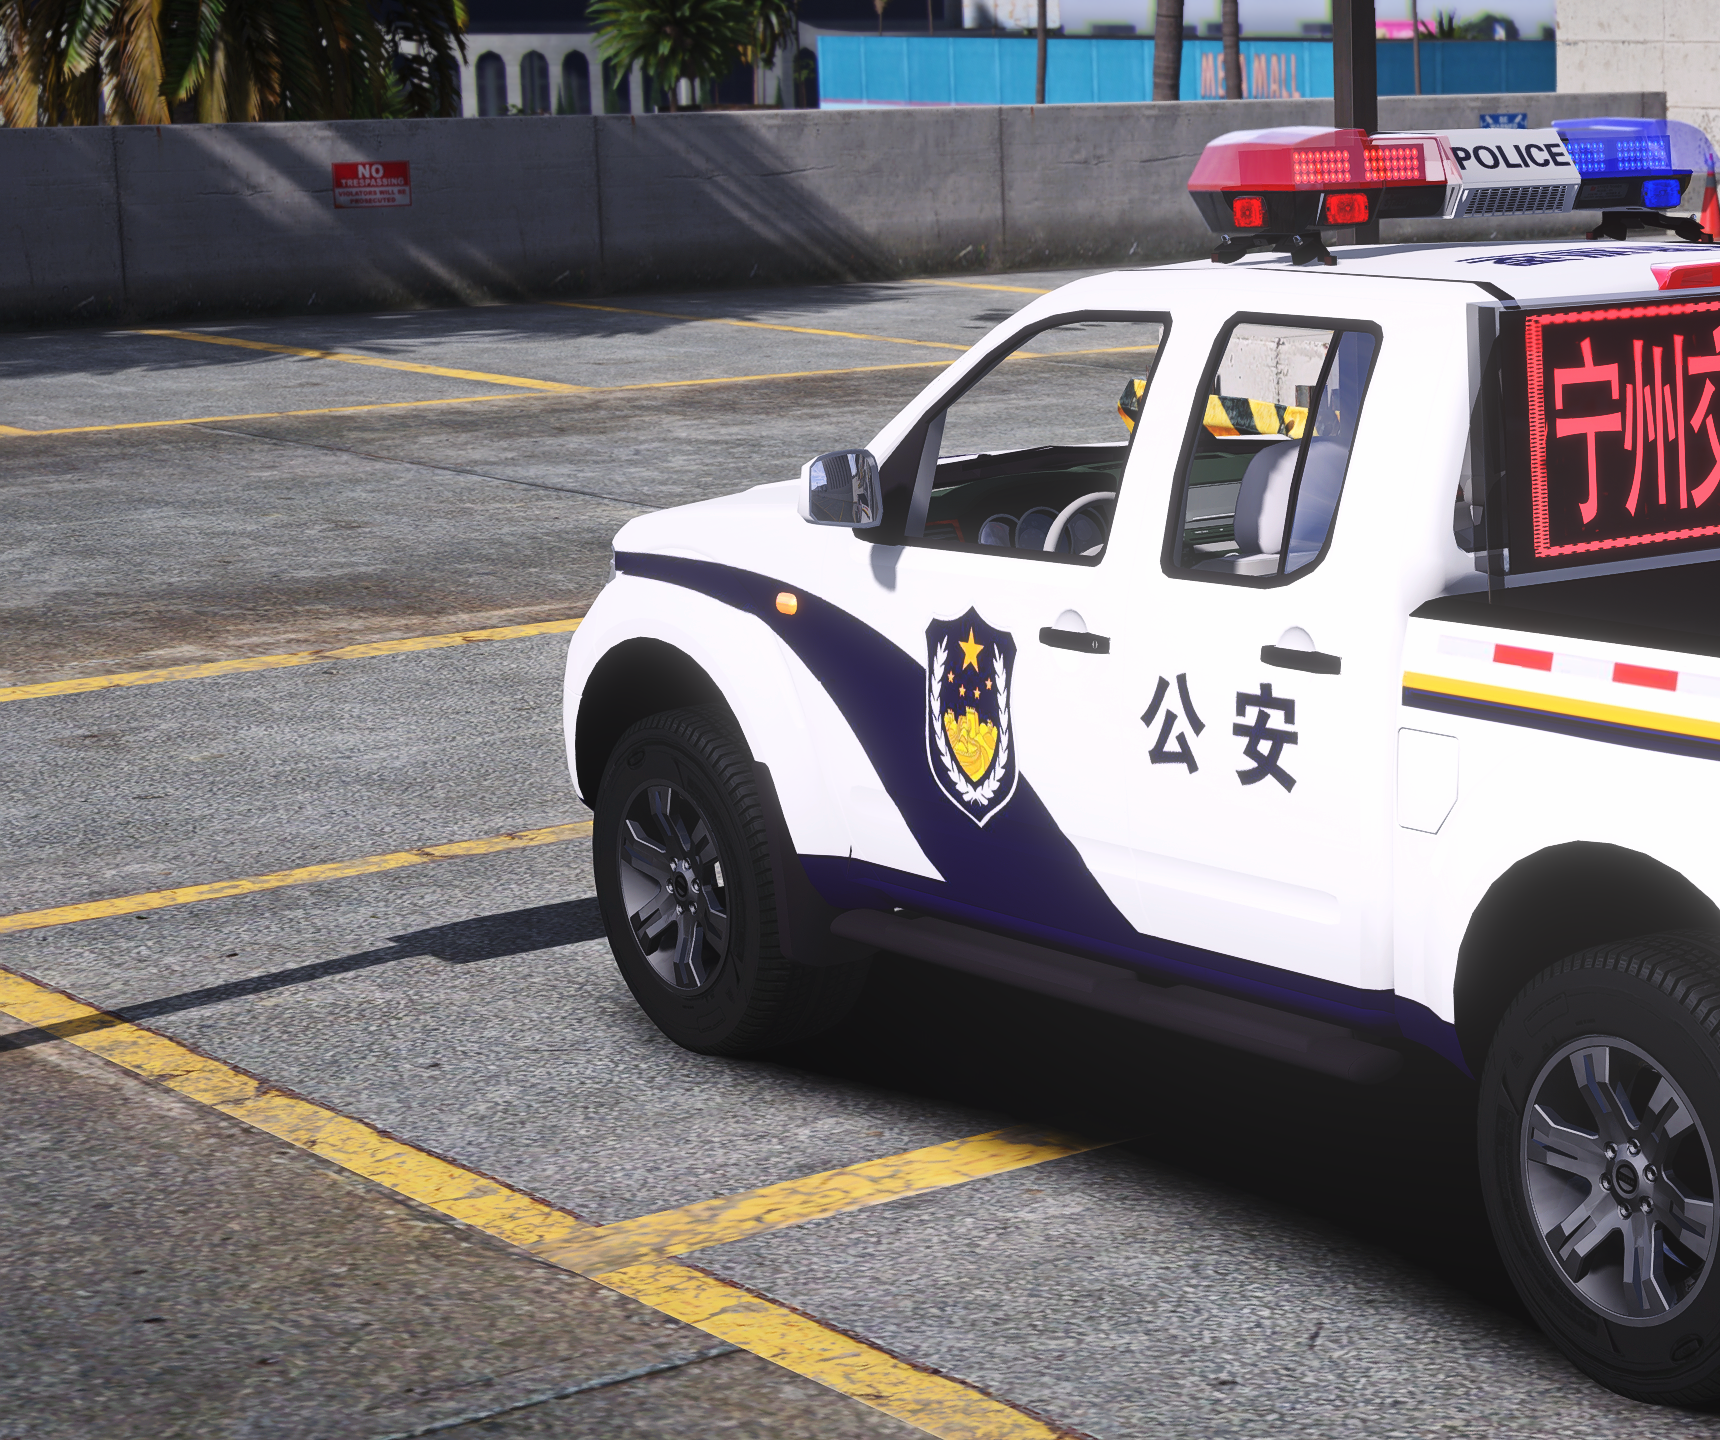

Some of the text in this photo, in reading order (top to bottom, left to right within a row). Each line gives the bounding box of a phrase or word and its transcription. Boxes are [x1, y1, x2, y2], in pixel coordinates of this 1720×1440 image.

[1201, 52, 1301, 98] MEA MALL
[1450, 143, 1572, 170] POLICE
[341, 177, 404, 187] TRESPASSING
[357, 164, 384, 178] NO
[1140, 672, 1299, 794] 公安
